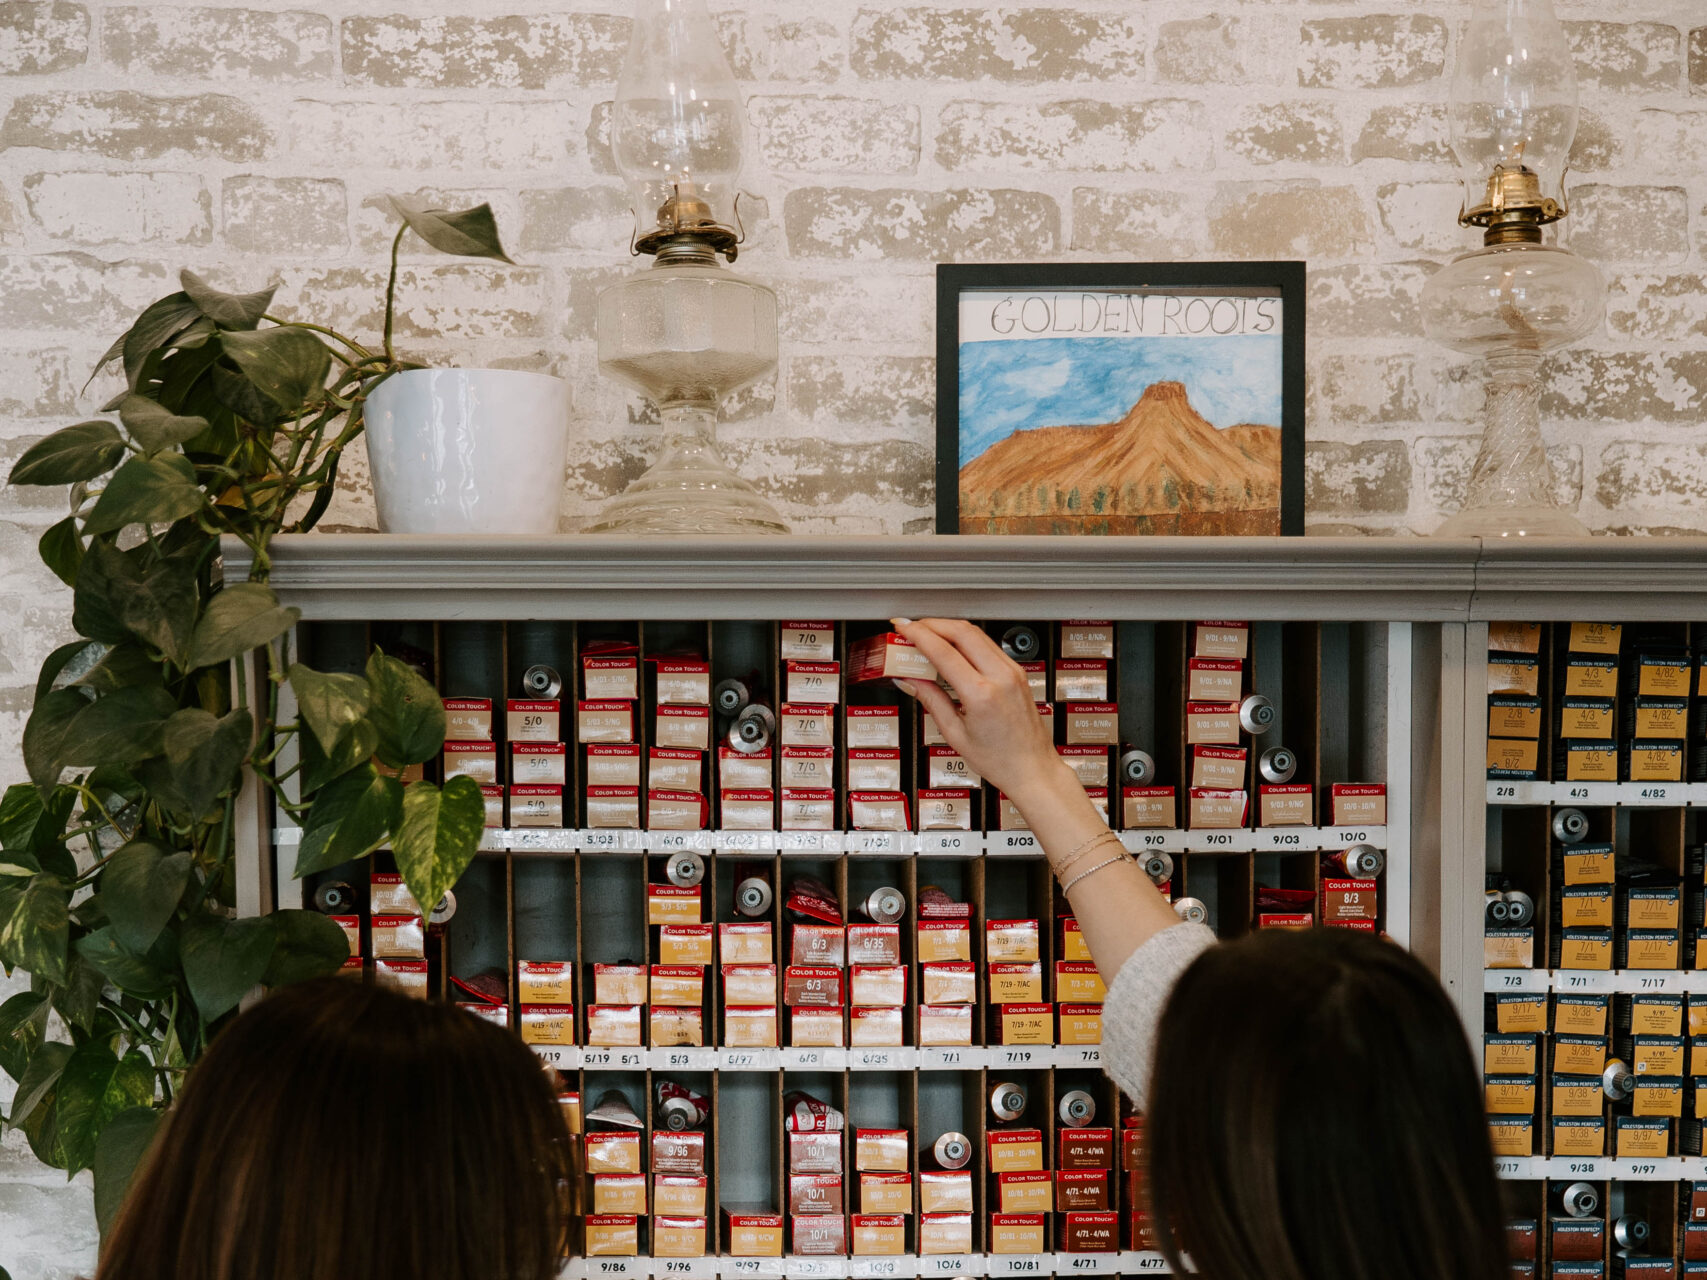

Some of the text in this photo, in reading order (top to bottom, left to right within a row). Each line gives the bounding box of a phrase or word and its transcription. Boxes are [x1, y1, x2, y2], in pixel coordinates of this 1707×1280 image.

[991, 294, 1277, 335] GOLDEN ROOTS
[799, 633, 816, 644] 7/0
[1584, 668, 1599, 679] 4/3
[1655, 667, 1675, 678] 4/82
[805, 677, 822, 687] 7/0
[1580, 709, 1595, 721] 4/3
[1652, 709, 1672, 721] 4/82
[524, 716, 543, 726] 5/0
[798, 720, 816, 730] 7/0
[1585, 751, 1600, 762] 4/3
[798, 762, 816, 772] 7/0
[946, 761, 965, 771] 8/0
[1497, 787, 1515, 797] 2/8
[1570, 788, 1589, 798] 4/3
[1641, 789, 1666, 798] 4/82
[527, 800, 545, 810] 5/0
[1007, 836, 1034, 846] 8/03
[1145, 835, 1165, 845] 9/0
[1206, 835, 1232, 845] 9/01
[1273, 835, 1300, 845] 9/03
[1339, 832, 1367, 842] 10/0
[941, 838, 961, 848] 8/0
[1343, 892, 1359, 905] 8/3
[811, 938, 827, 950] 6/3
[864, 938, 884, 949] 6/35
[806, 979, 822, 991] 6/3
[1504, 977, 1522, 986] 7/3
[1570, 977, 1587, 986] 7/1
[1641, 979, 1665, 988] 7/17
[1512, 1004, 1531, 1014] 9/17
[1082, 1051, 1100, 1060] 7/3
[1501, 1045, 1520, 1056] 9/17
[585, 1054, 640, 1065] 5/19 5/1
[670, 1055, 689, 1064] 5/3
[799, 1054, 818, 1063] 6/3
[863, 1054, 888, 1064] 6/35
[942, 1053, 960, 1062] 7/1
[1006, 1052, 1031, 1061] 7/19
[1501, 1086, 1519, 1096] 9/17
[1568, 1088, 1588, 1098] 9/38
[1570, 1127, 1589, 1138] 9/38
[668, 1145, 688, 1157] 9/96
[806, 1145, 825, 1157] 10/1
[1570, 1163, 1595, 1173] 9/38
[1632, 1165, 1656, 1174] 9/97
[806, 1188, 825, 1200] 10/1
[810, 1229, 828, 1241] 10/1
[601, 1262, 626, 1272] 9/86
[666, 1262, 691, 1272] 9/96
[735, 1262, 760, 1271] 9/97
[937, 1260, 962, 1269] 10/6
[1008, 1261, 1039, 1271] 10/81
[1073, 1259, 1097, 1268] 4/71
[1140, 1259, 1165, 1268] 4/77
